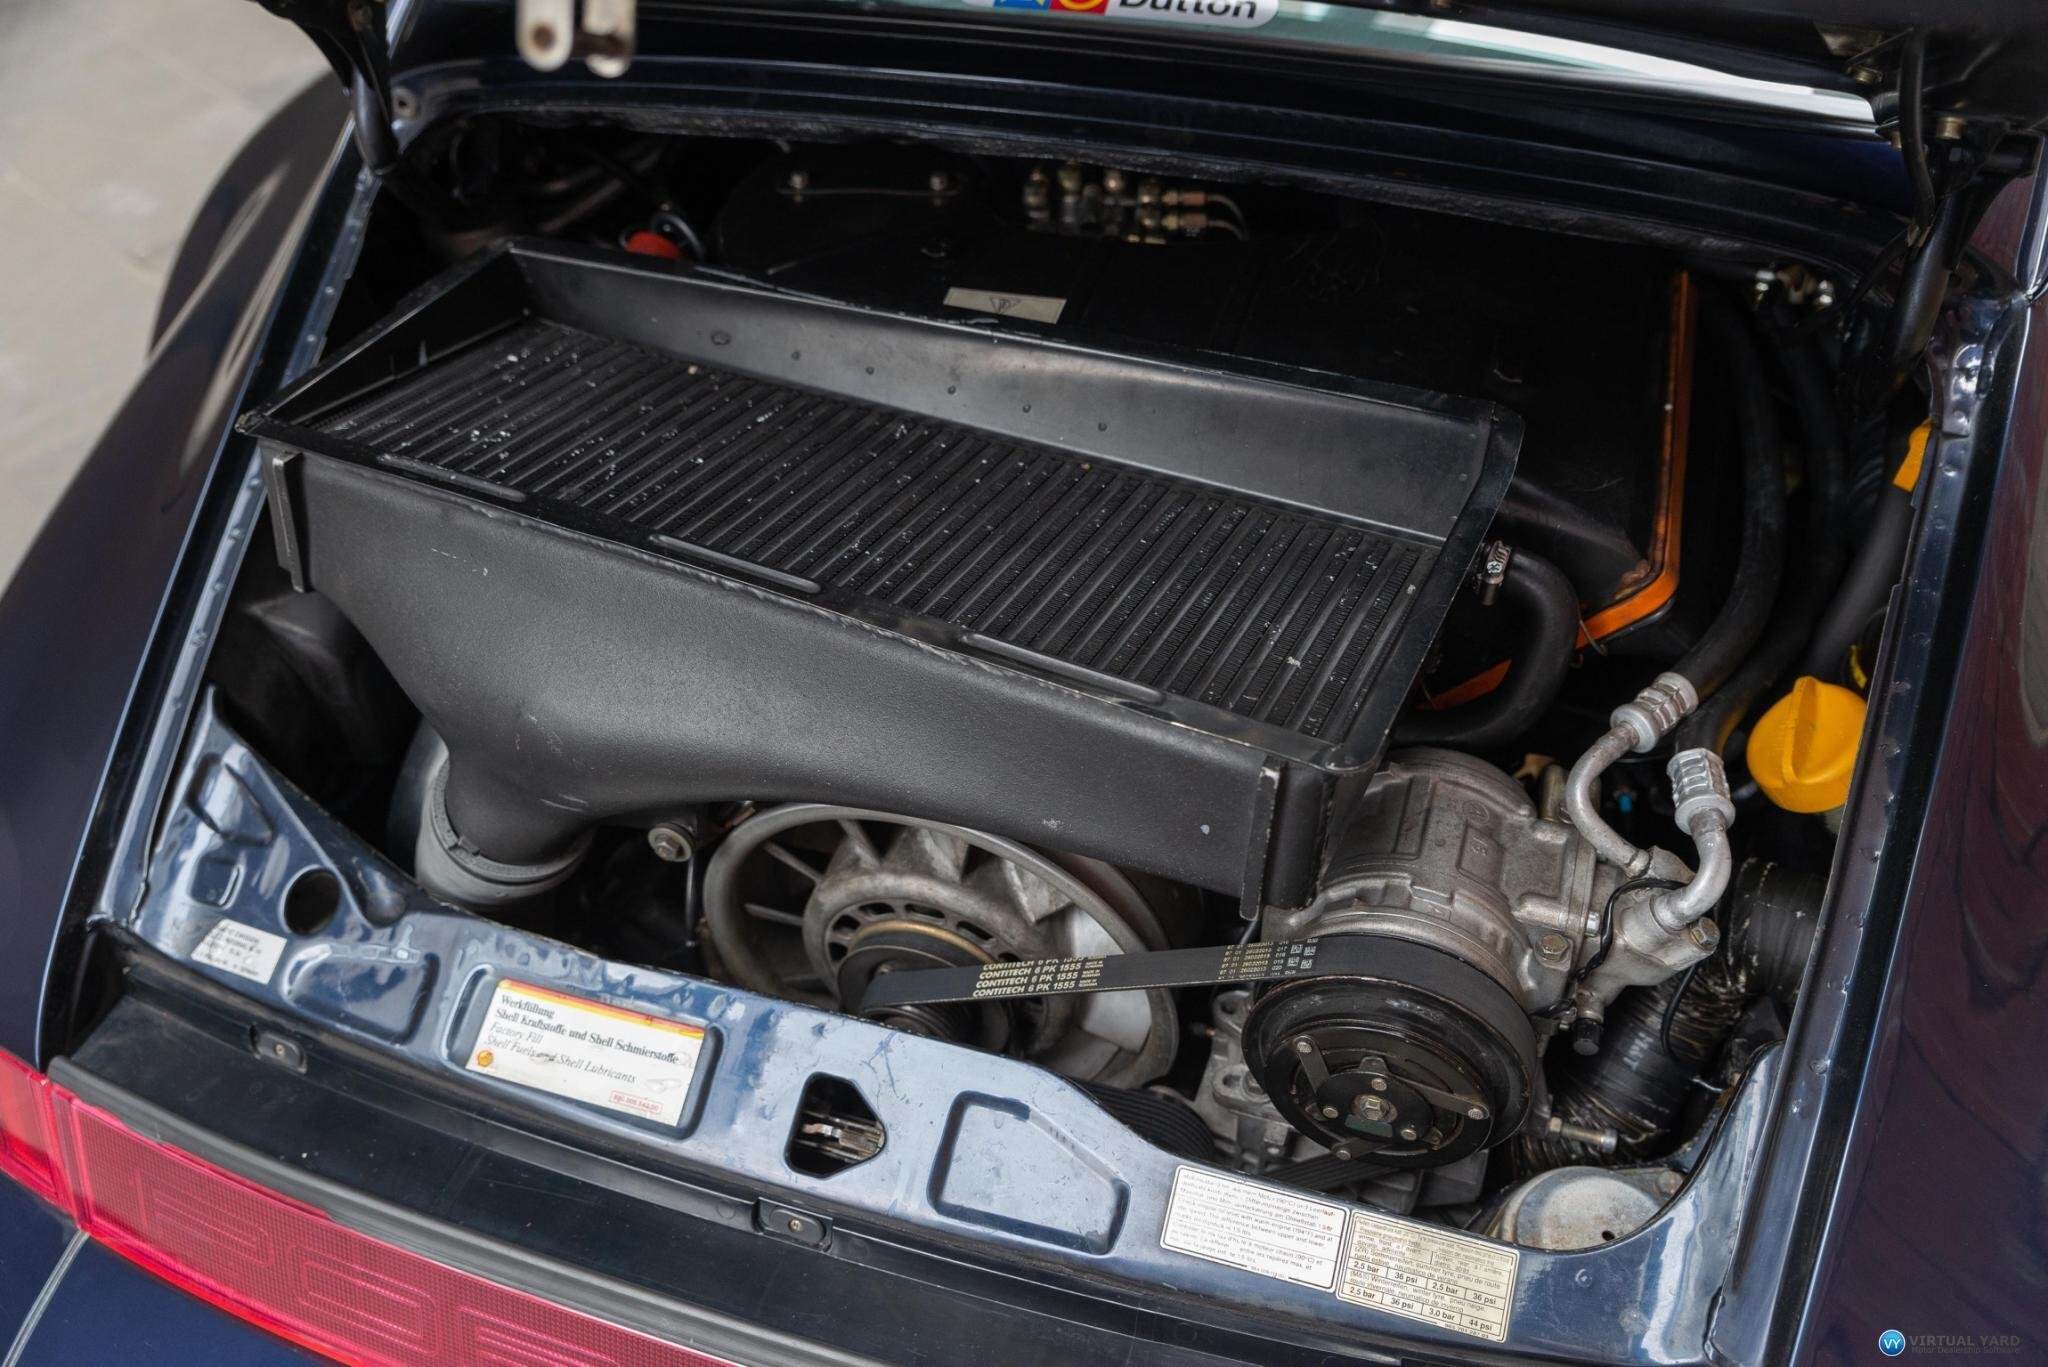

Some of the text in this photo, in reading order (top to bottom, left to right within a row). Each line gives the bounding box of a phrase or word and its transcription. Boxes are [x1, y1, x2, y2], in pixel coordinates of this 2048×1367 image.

[979, 963, 1082, 979] CONTITECH 6 PK 1555
[976, 972, 1079, 989] CONTITECH 6 PK 1555
[972, 981, 1075, 997] CONTITECH 6 PK 1555
[499, 994, 555, 1019] Werkfüllung
[490, 1021, 543, 1043] Factory Fill
[495, 1007, 679, 1065] Shell Kraftstoffe und Shell Schmierstoffe
[486, 1034, 510, 1049] Shell
[511, 1041, 536, 1056] Fuels
[558, 1054, 583, 1069] Shell
[584, 1061, 637, 1084] Lubricants
[1295, 1235, 1306, 1243] and
[1308, 1238, 1324, 1247] lower
[1314, 1232, 1325, 1240] and
[1367, 1265, 1379, 1274] bar
[1427, 1271, 1435, 1279] de
[1394, 1272, 1417, 1284] 36 psi
[1457, 1272, 1473, 1282] pneu
[1474, 1277, 1483, 1285] de
[1484, 1279, 1500, 1289] route
[1362, 1290, 1375, 1300] bar
[1412, 1286, 1430, 1297] winter
[1449, 1296, 1465, 1306] pneu
[1445, 1285, 1458, 1294] bar
[1390, 1297, 1413, 1310] 36 psi
[1472, 1292, 1496, 1305] 36 psi
[1442, 1311, 1454, 1321] bar
[1468, 1318, 1492, 1331] 44 psi
